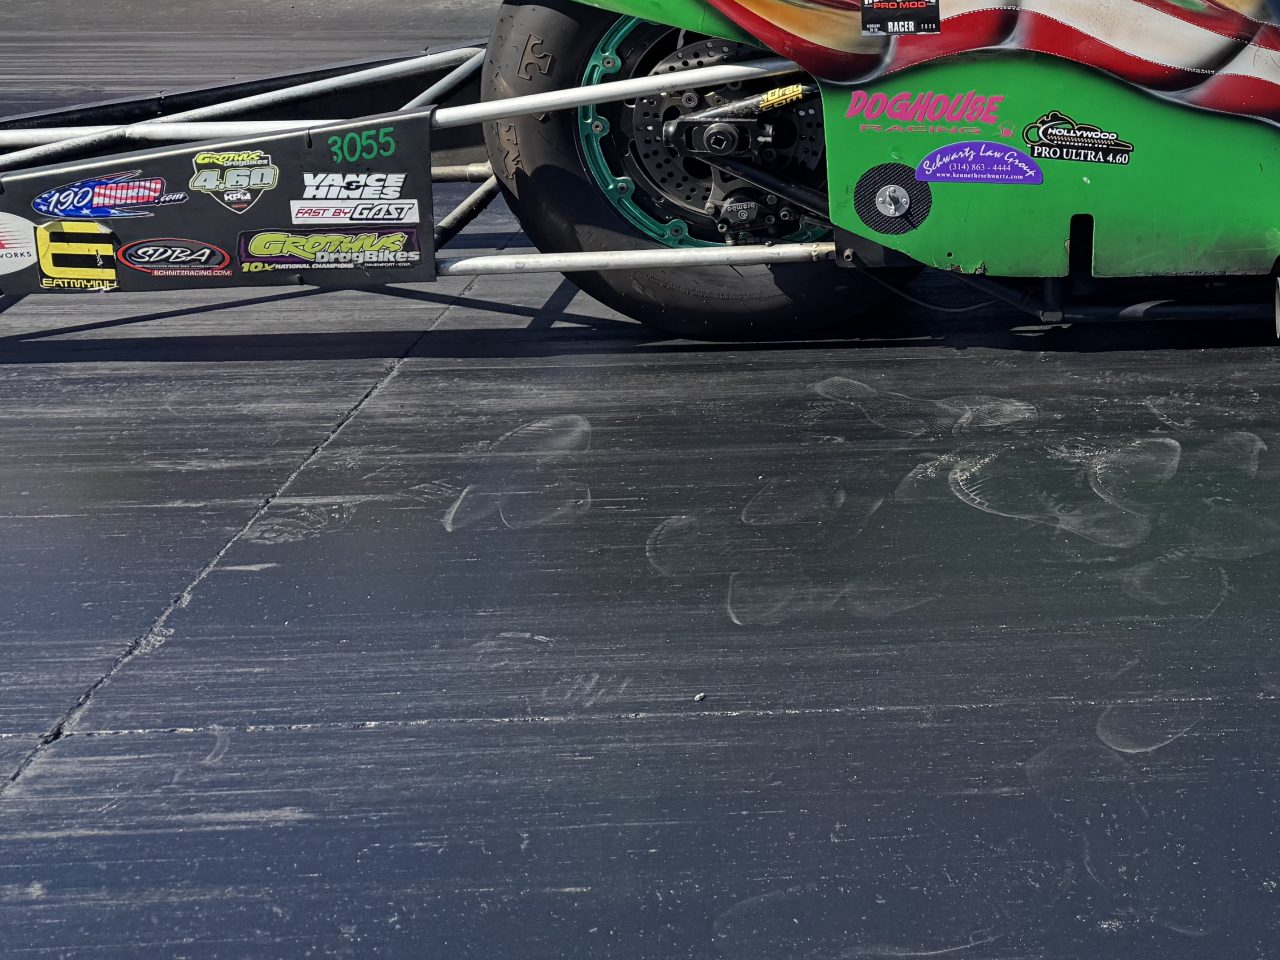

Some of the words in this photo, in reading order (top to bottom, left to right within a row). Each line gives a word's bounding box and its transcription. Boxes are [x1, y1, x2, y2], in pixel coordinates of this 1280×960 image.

[899, 1, 927, 9] MOD
[888, 21, 915, 33] RACER
[845, 90, 1004, 125] DOGHOUSE
[859, 124, 982, 135] RACING
[1047, 127, 1117, 140] HOLLYWOOD
[328, 127, 396, 164] 3055
[923, 147, 976, 175] Schwartz
[979, 144, 1004, 158] Law
[1004, 152, 1037, 177] Group
[1033, 146, 1060, 158] PRO
[1062, 149, 1105, 162] ULTRA
[1106, 153, 1129, 164] 4.60
[949, 163, 969, 172] (314)
[193, 168, 275, 190] 4.60
[303, 173, 406, 186] VANCE
[303, 186, 401, 199] HINES
[295, 208, 329, 217] FAST
[332, 208, 352, 217] BY
[350, 203, 415, 221] GAST
[249, 232, 408, 261] GROTHUS
[131, 247, 211, 263] SDBA
[315, 251, 421, 263] DragBikes
